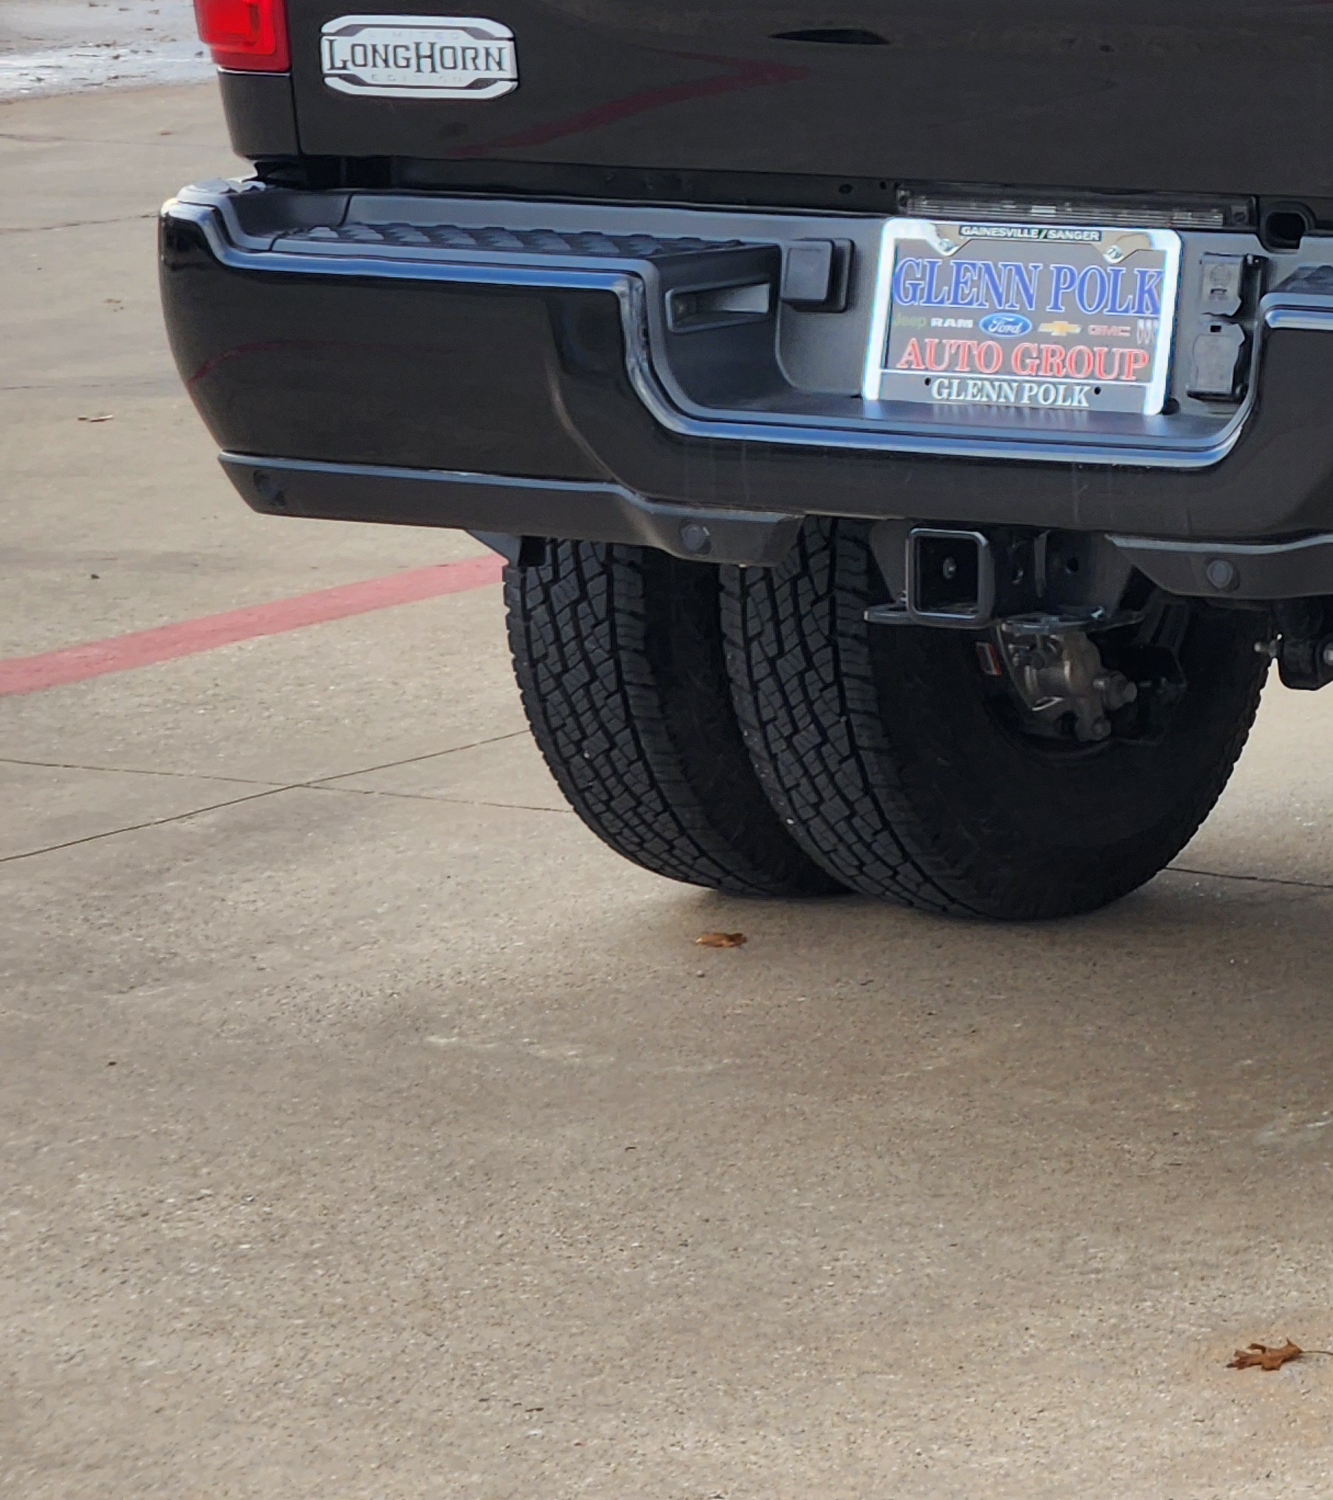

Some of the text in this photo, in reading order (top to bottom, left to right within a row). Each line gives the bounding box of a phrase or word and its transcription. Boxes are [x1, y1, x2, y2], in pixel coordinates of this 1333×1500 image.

[325, 39, 507, 74] LONGHORN
[892, 258, 1164, 317] GLENN POLK
[930, 318, 974, 328] RAM
[987, 316, 1023, 334] Ford
[1088, 325, 1131, 337] GMC
[896, 338, 1150, 381] AUTO GROUP
[931, 378, 1090, 408] GLENN POLK
